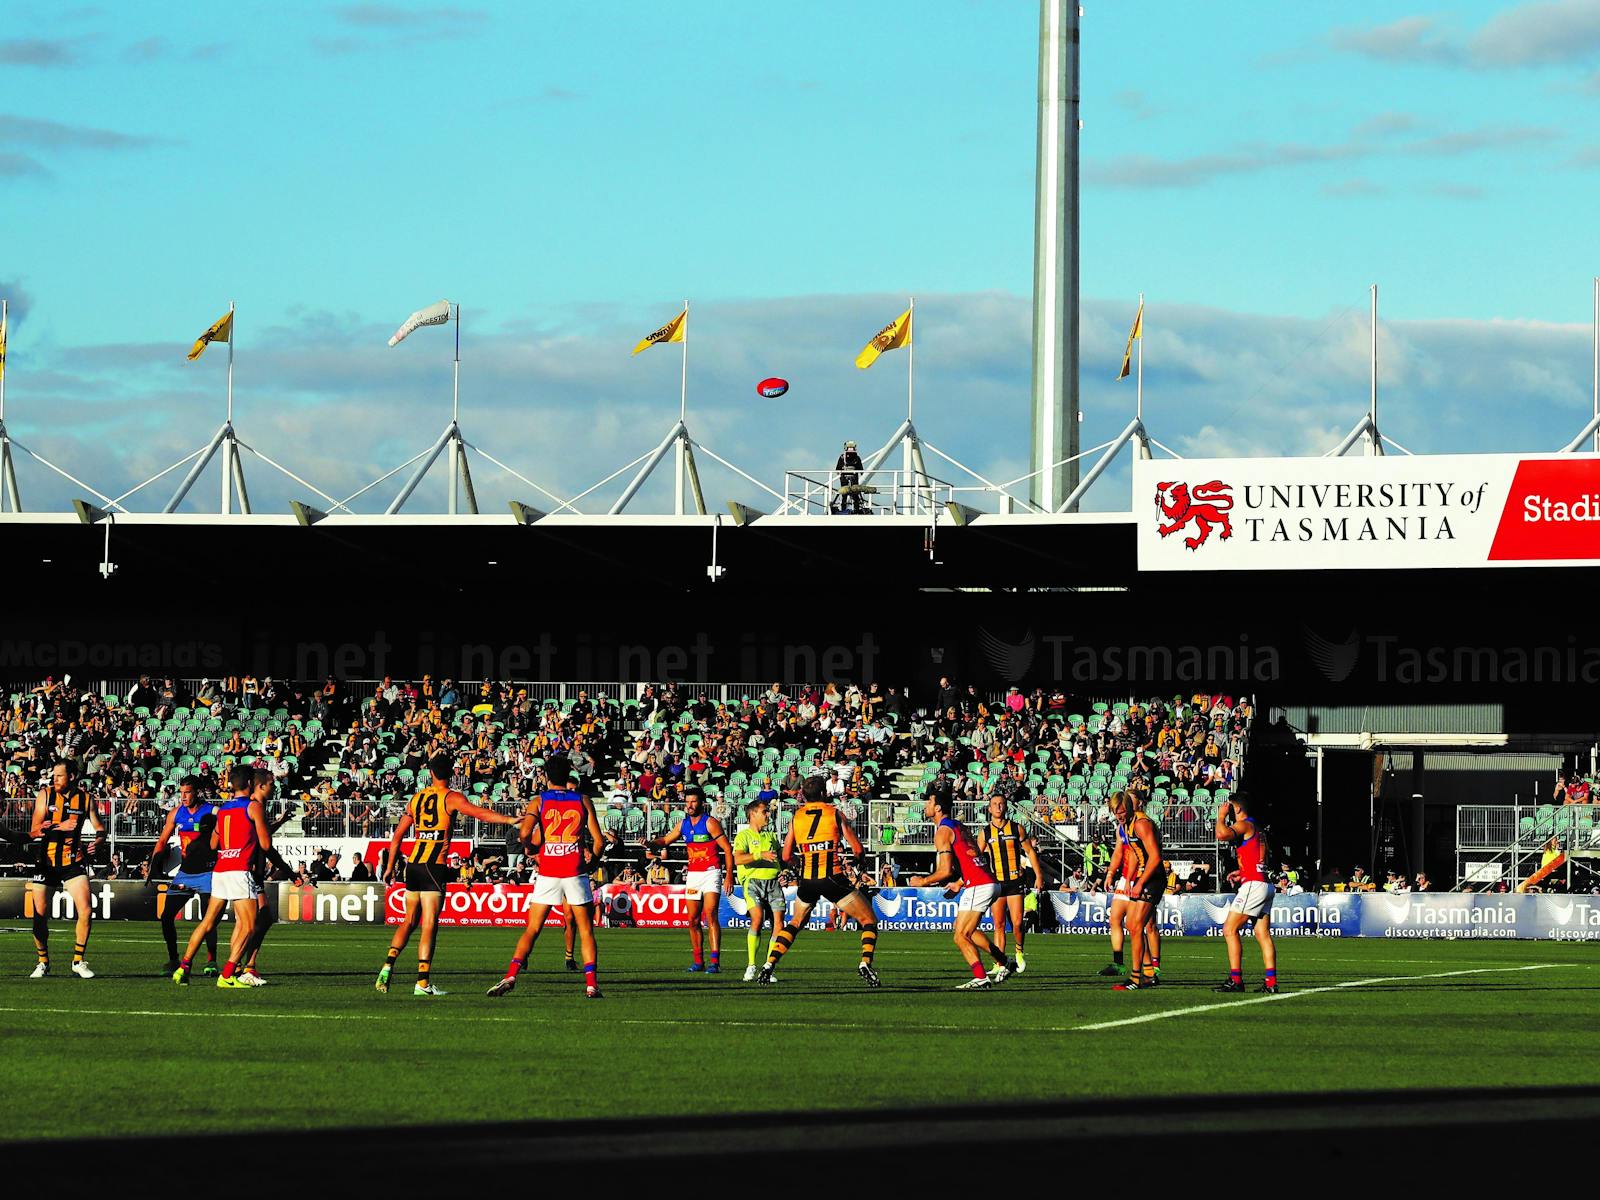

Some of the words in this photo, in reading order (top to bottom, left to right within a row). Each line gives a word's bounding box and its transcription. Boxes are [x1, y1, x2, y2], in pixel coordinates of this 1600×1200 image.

[1243, 483, 1455, 509] UNIVERSITY
[1460, 482, 1488, 513] of
[1523, 494, 1600, 522] Stadi
[1245, 516, 1456, 541] TASMANIA
[0, 639, 224, 668] McDonald's
[1042, 633, 1279, 682] Tasmania
[1366, 635, 1600, 684] Tasmania
[415, 793, 439, 828] 19
[544, 808, 581, 843] 22
[805, 809, 823, 840] 7
[224, 815, 231, 849] 1
[288, 885, 379, 922] iinet
[605, 893, 688, 914] OYOT
[1270, 904, 1341, 923] mania
[1412, 902, 1516, 924] Tasmania
[1384, 927, 1516, 937] discovertasmania.com
